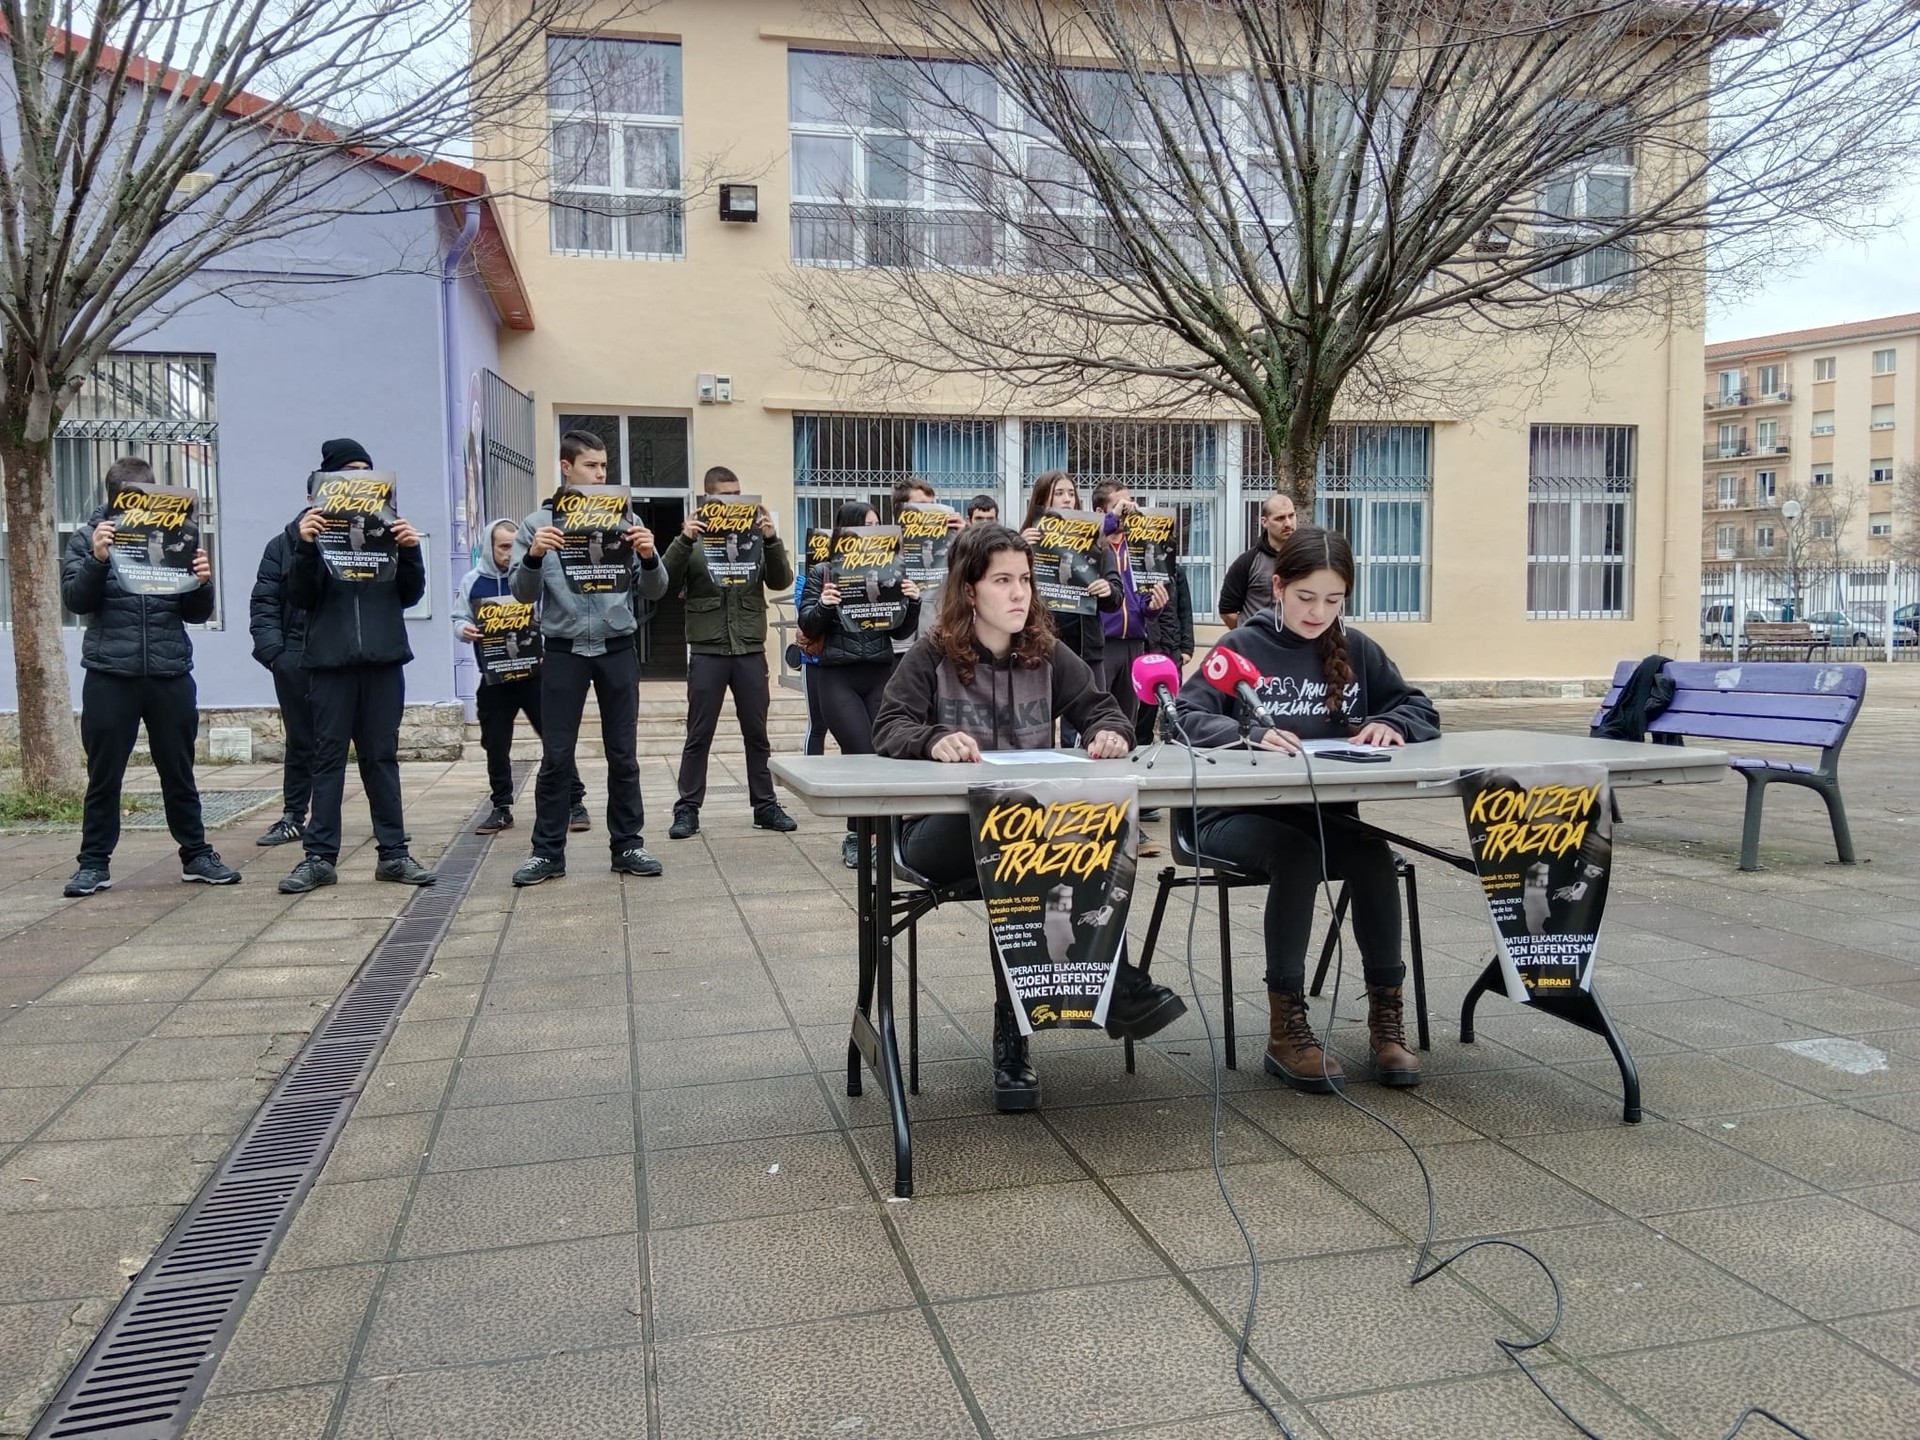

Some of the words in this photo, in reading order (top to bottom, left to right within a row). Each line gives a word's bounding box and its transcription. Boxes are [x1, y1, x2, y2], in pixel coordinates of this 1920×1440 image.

[317, 479, 391, 498] KONTZEN
[113, 492, 194, 512] KONTZEN
[322, 495, 386, 515] TRAZIOA
[556, 494, 628, 513] KONTZEN
[700, 502, 758, 518] KONTZEN
[121, 509, 187, 530] TRAZIOA
[564, 511, 622, 530] TRAZIOA
[706, 517, 753, 533] TRAZIOA
[898, 510, 948, 525] KONTZE
[1036, 515, 1100, 536] KONTZEN
[1124, 513, 1175, 529] KONTZEN
[903, 523, 948, 539] TRAZIOA
[1127, 526, 1170, 544] TRAZIOA
[835, 534, 899, 553] KONTZEN
[1039, 532, 1094, 552] TRAZIOA
[842, 551, 895, 571] TRAZIOA
[477, 602, 533, 619] KONTZEN
[484, 615, 530, 633] TRAZIOA
[938, 697, 1050, 729] ERRAKI
[1470, 783, 1602, 824] KONTZEN
[980, 798, 1132, 842] KONTZEN
[1481, 820, 1589, 864] TRAZIOA
[994, 839, 1117, 886] TRAZIOA
[1009, 963, 1052, 976] ZIPERATUEI
[1053, 962, 1112, 972] ELKARTASUN
[1013, 973, 1050, 988] AZIOEN
[1052, 972, 1108, 984] DEFENTSA
[1538, 978, 1571, 986] ERRAKI
[1060, 1009, 1093, 1019] ERRAKI
